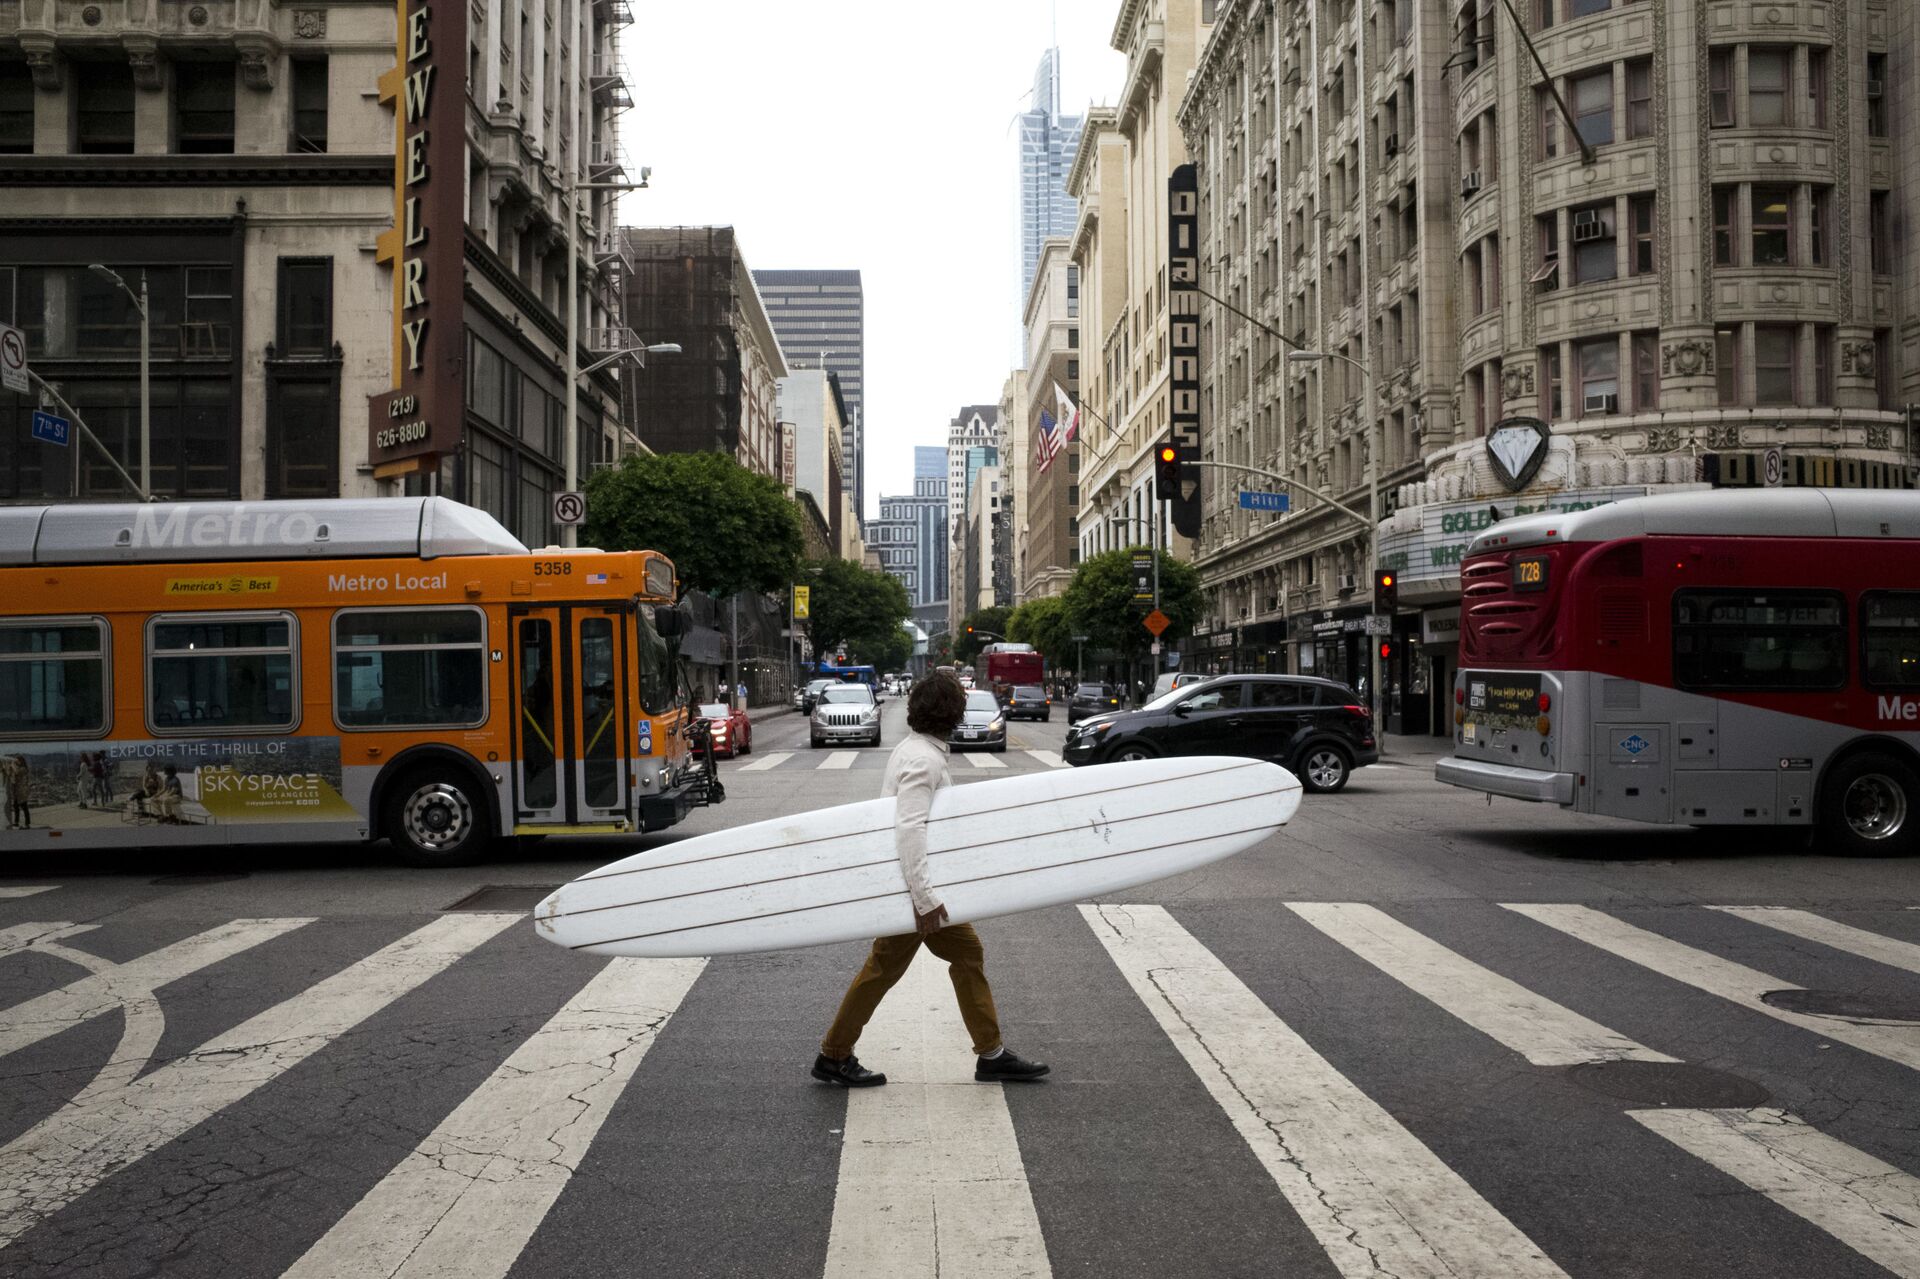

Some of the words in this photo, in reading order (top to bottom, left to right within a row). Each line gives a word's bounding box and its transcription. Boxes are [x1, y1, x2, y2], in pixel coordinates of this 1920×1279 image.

[388, 394, 414, 419] (213)
[37, 416, 52, 434] 7th
[54, 423, 64, 438] St
[376, 420, 426, 449] 626-8800
[783, 428, 794, 437] LA
[131, 505, 317, 549] Metro
[533, 561, 572, 576] 5358
[1519, 561, 1541, 582] 728
[171, 580, 223, 593] America's
[248, 579, 272, 591] Best
[328, 574, 388, 592] Metro
[395, 571, 447, 590] Local
[492, 651, 501, 661] M
[1503, 687, 1516, 699] HIP
[1517, 687, 1534, 700] HOP
[110, 744, 174, 758] EXPLORE
[178, 744, 207, 756] THE
[214, 742, 263, 756] THRILL
[266, 741, 287, 754] OF
[1624, 740, 1645, 749] CNG
[204, 773, 319, 792] SKYSPACE
[262, 791, 278, 799] LOS
[280, 790, 319, 798] ANGELES
